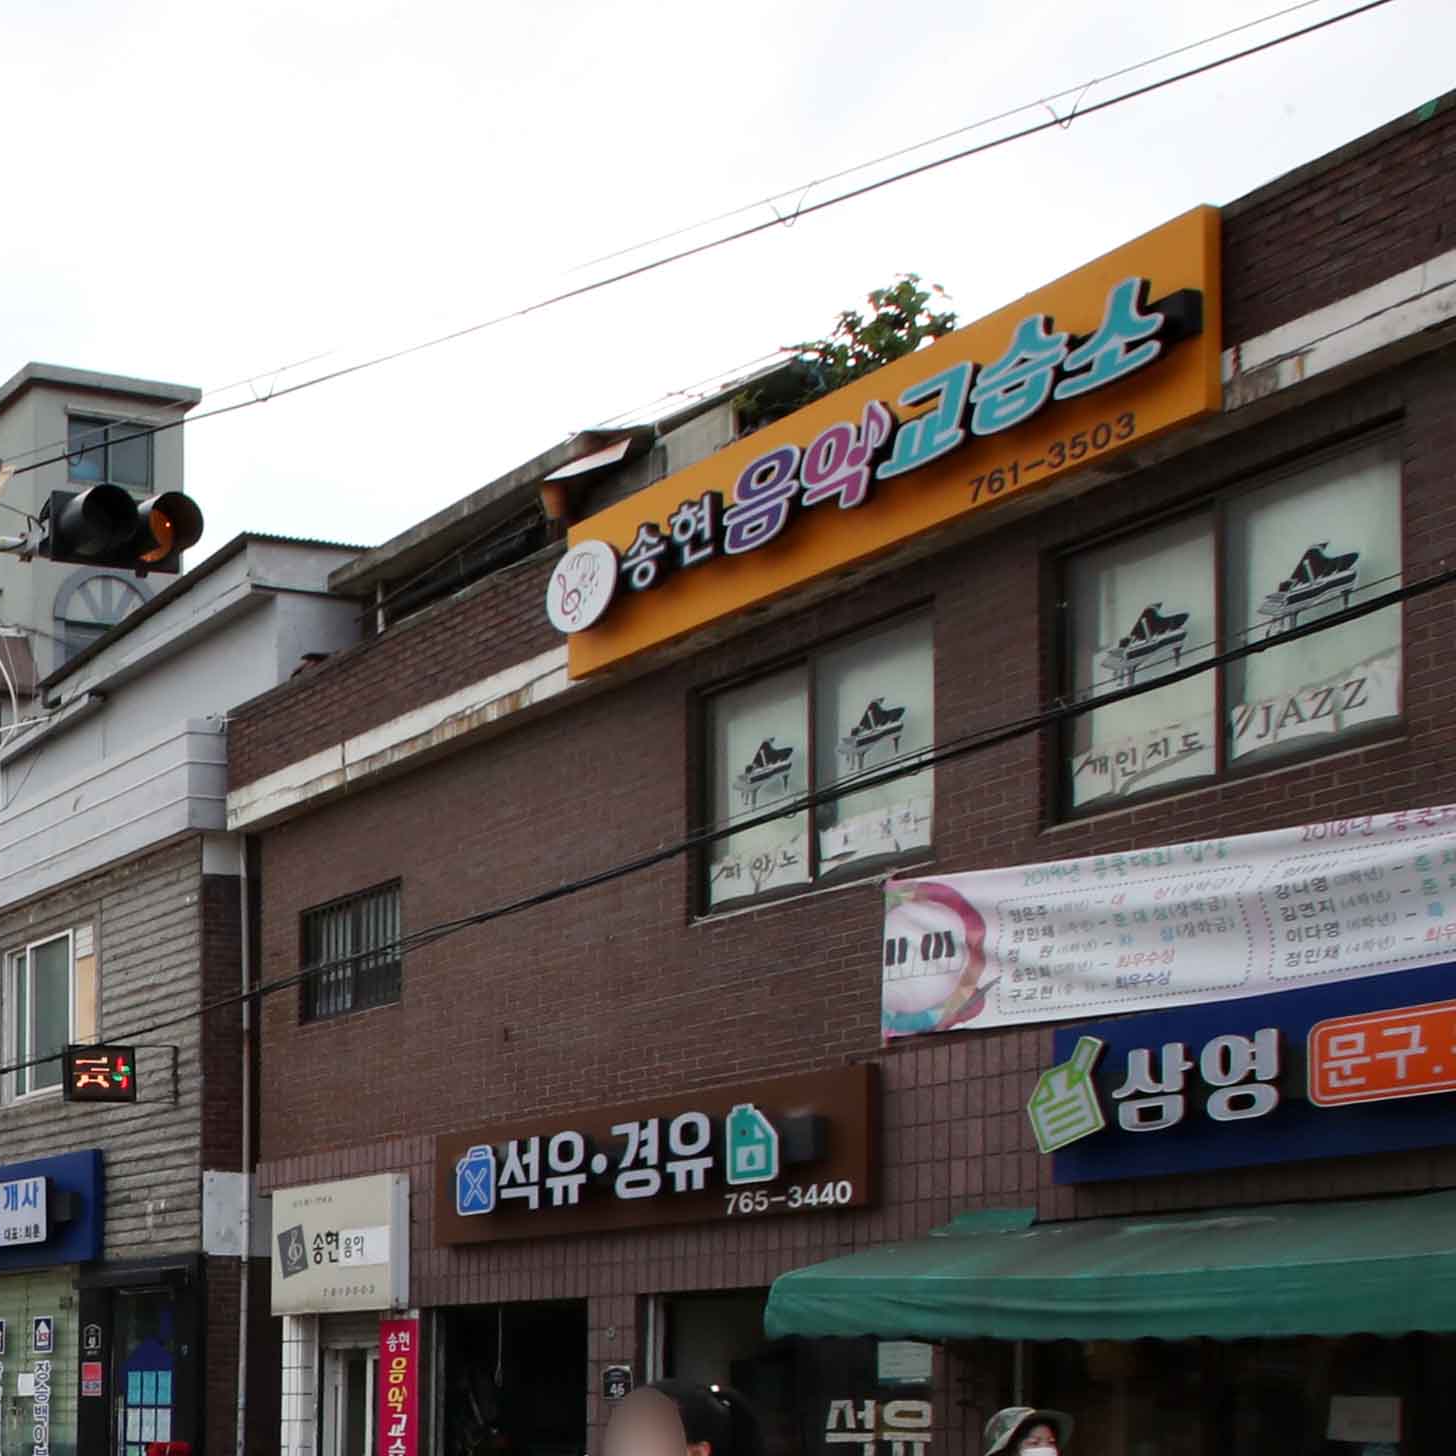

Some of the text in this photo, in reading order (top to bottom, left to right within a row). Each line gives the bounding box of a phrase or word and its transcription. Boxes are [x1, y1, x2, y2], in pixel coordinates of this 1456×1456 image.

[622, 277, 1166, 592] 송현 음악교습소
[968, 412, 1138, 503] 761-3503
[1255, 676, 1369, 740] JAZZ
[1111, 1026, 1280, 1133] 삼영
[724, 1180, 852, 1217] 765-3440
[312, 1230, 365, 1265] 송현 음악
[385, 1331, 411, 1353] 송현
